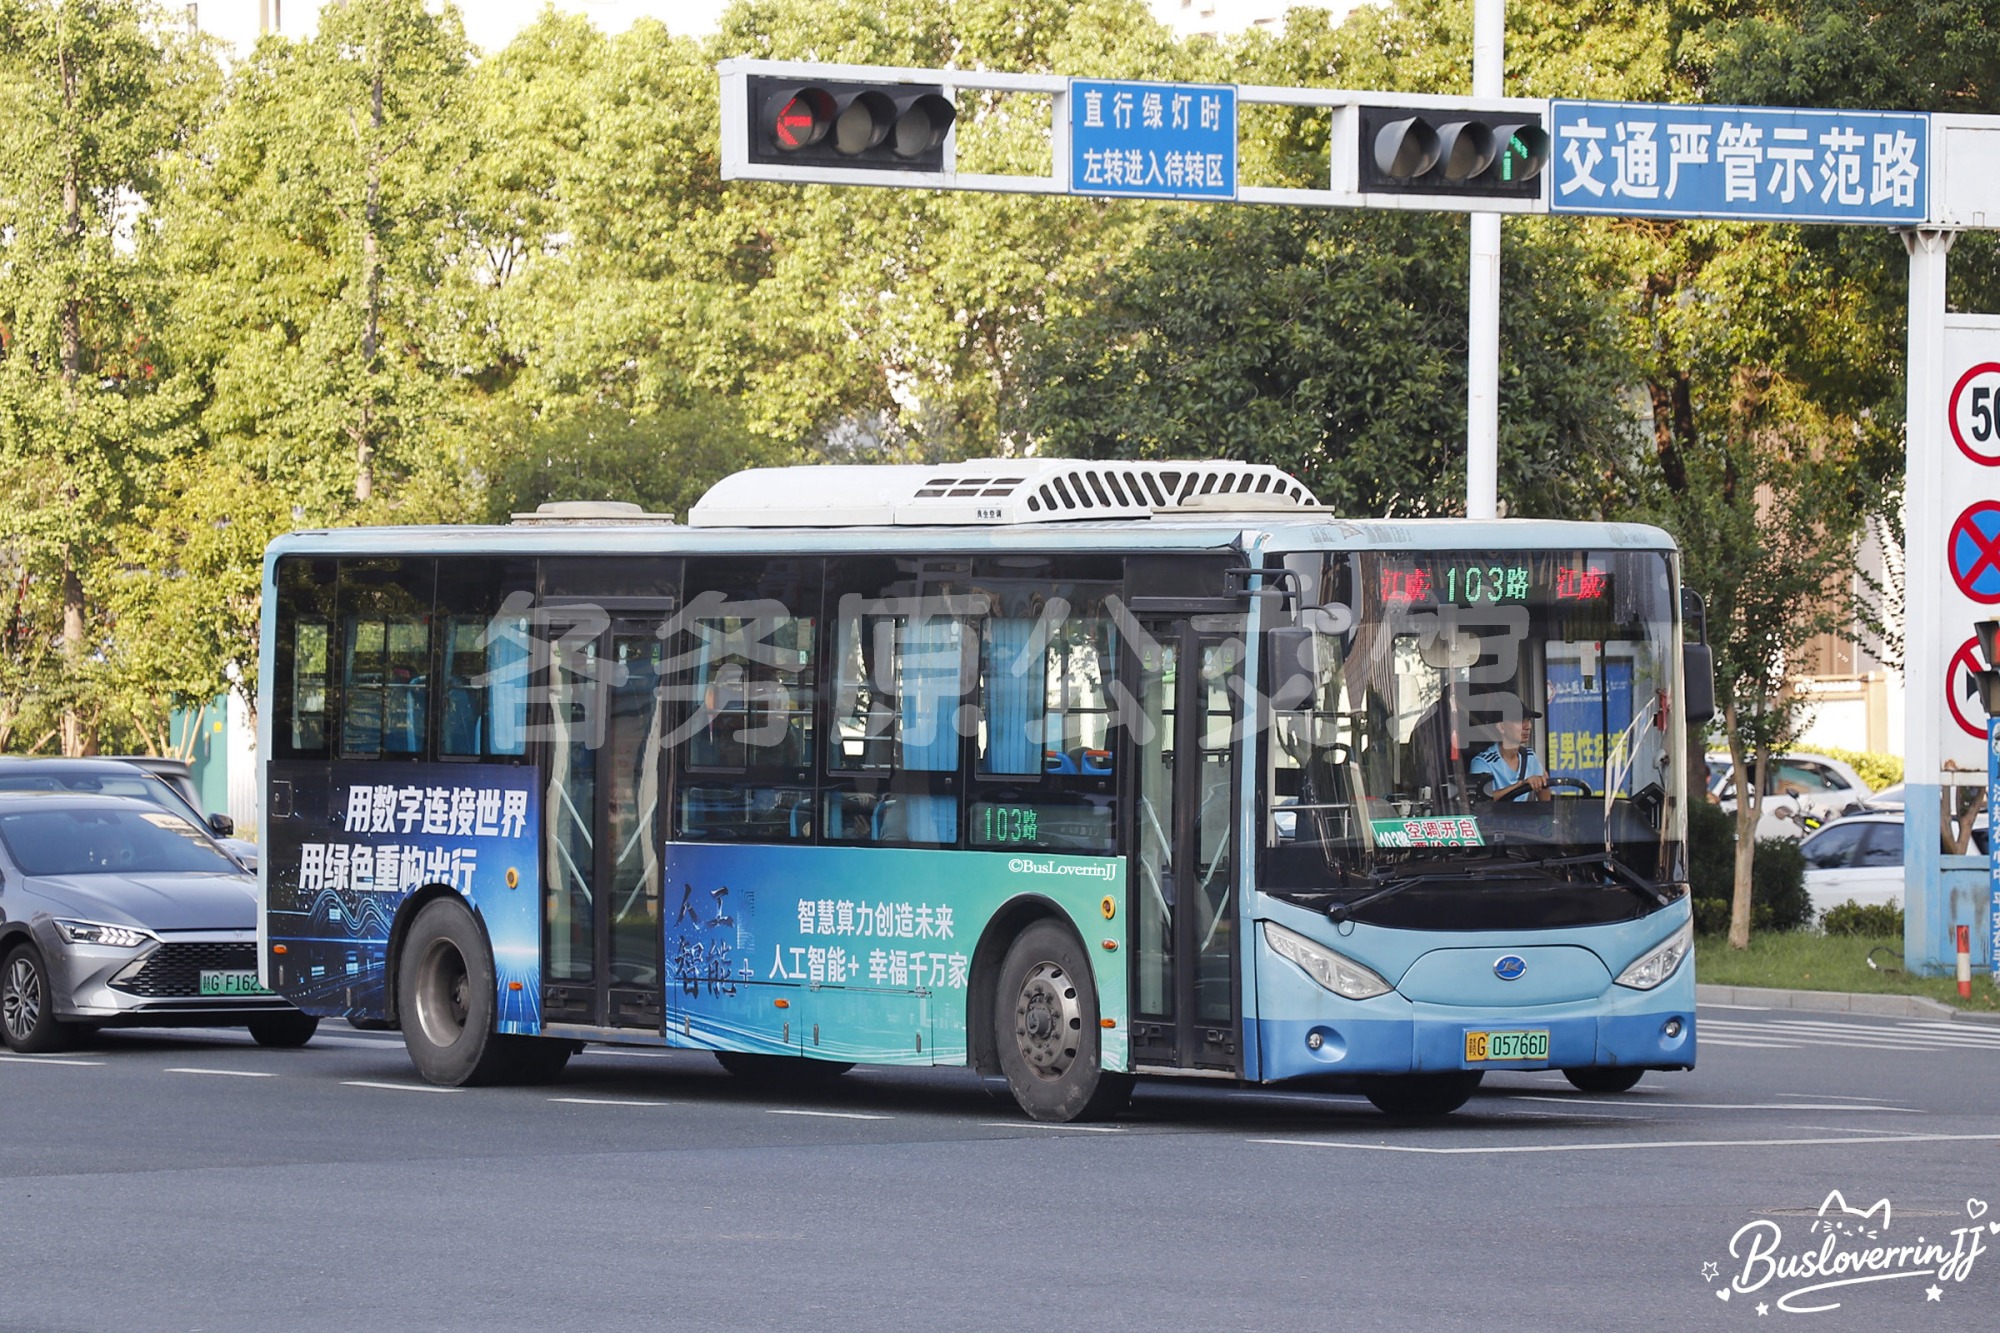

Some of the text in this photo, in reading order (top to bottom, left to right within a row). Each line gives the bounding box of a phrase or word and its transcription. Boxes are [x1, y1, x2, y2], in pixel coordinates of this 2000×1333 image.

[1083, 89, 1221, 132] 直行绿灯时
[1083, 147, 1224, 188] 左转进入待转区
[1559, 117, 1920, 207] 交通严管示范路
[1447, 566, 1529, 602] 103路
[344, 785, 528, 839] 用数字连接世界
[985, 807, 1038, 842] 103路
[1404, 820, 1477, 839] 空调开启
[298, 843, 478, 895] 用绿色重构出行
[797, 898, 954, 940] 智慧算力创造未来
[768, 944, 969, 989] 人工智能+ 幸福千万家
